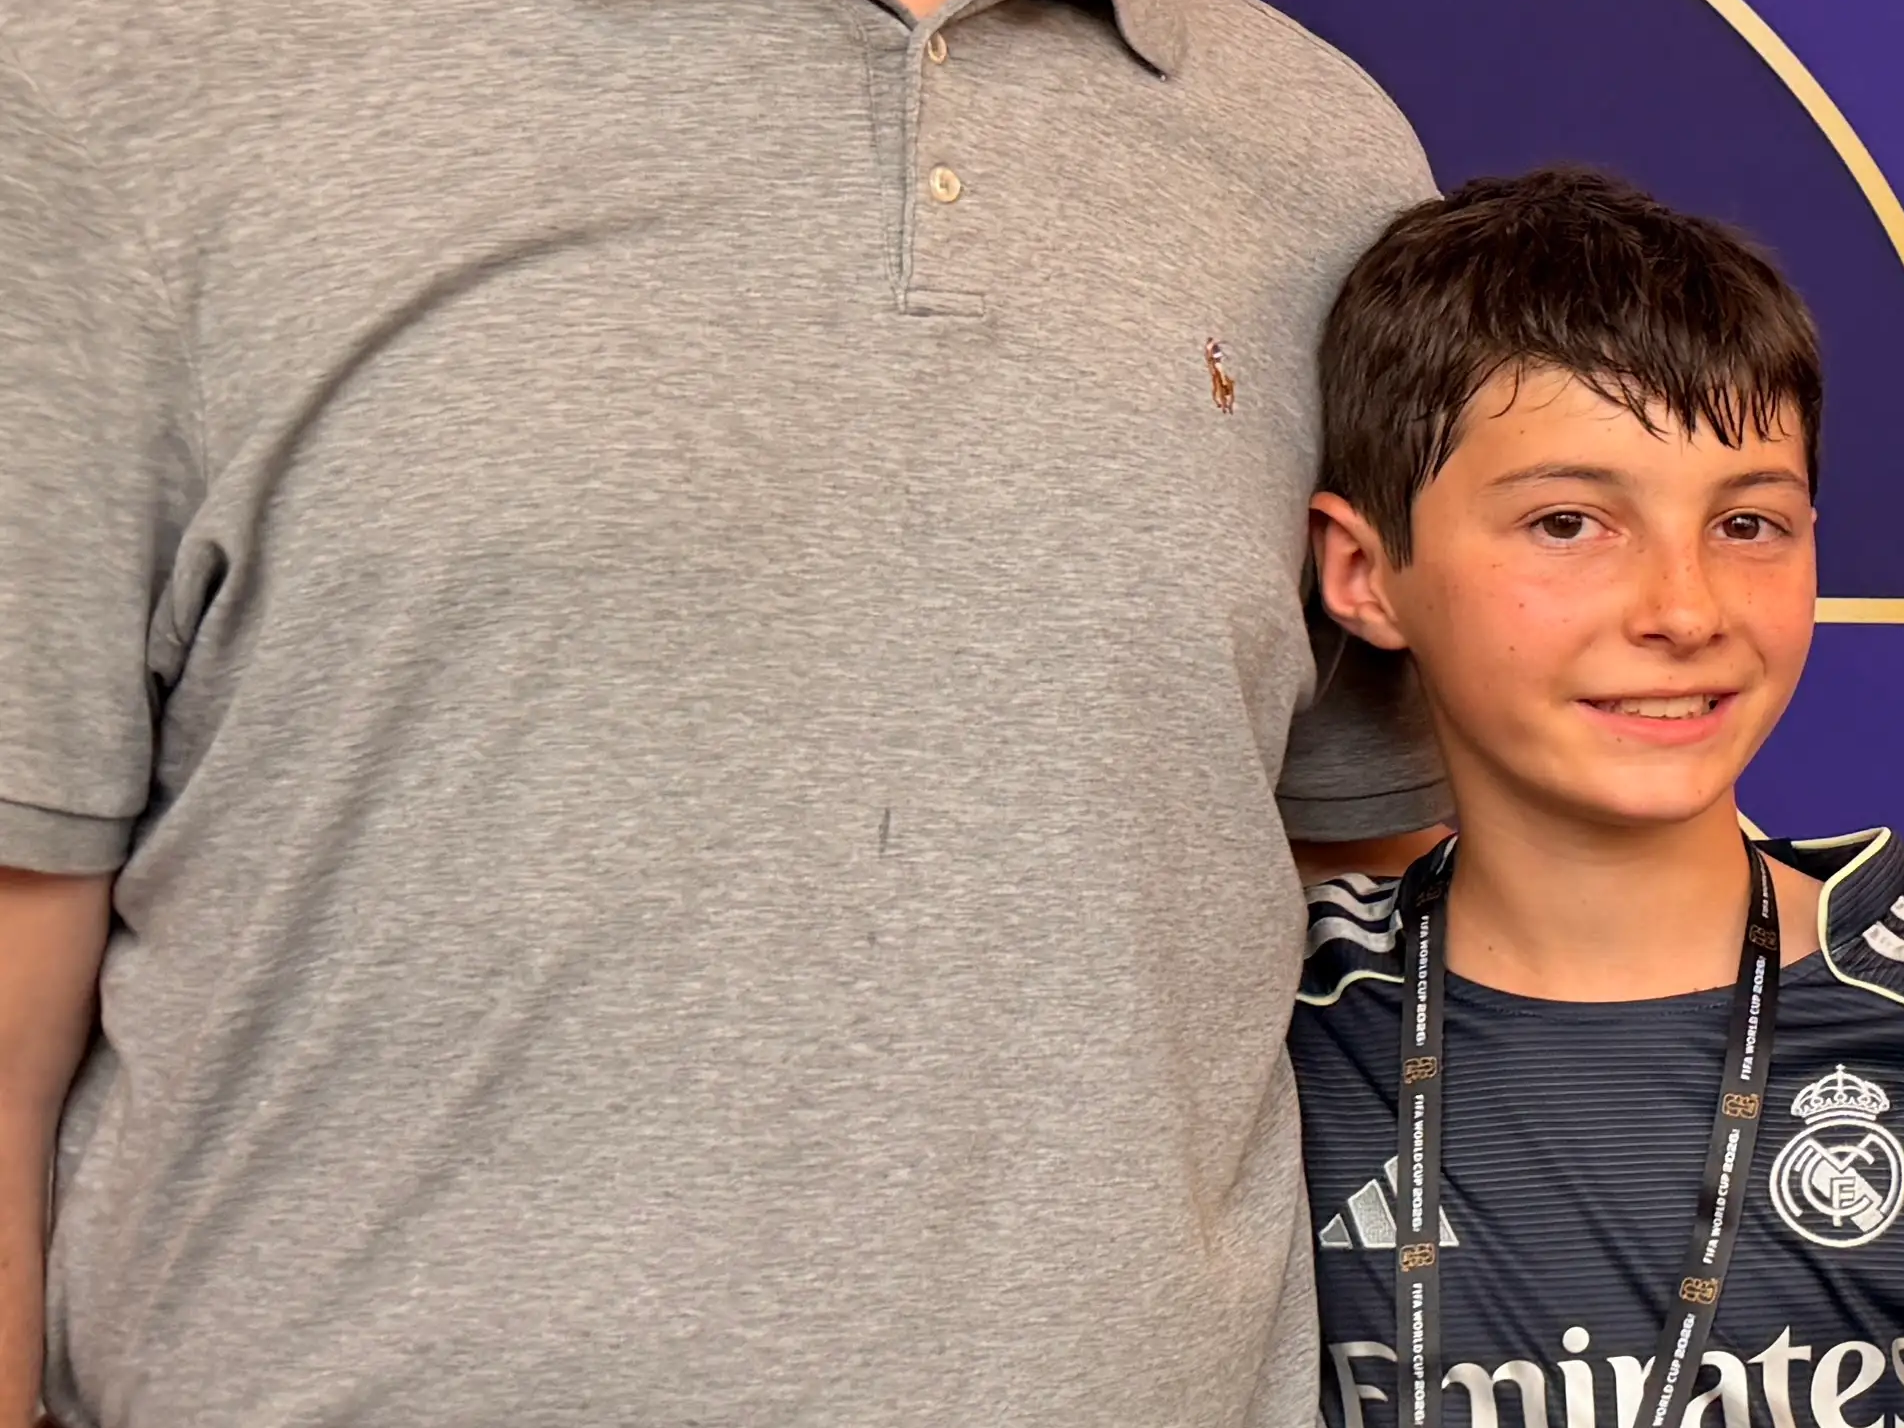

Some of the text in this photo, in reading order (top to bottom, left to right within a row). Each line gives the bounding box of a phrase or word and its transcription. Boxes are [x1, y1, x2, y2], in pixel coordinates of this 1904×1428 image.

[1718, 1173, 1730, 1197] CUP
[1711, 1197, 1728, 1237] WORLD
[1652, 1384, 1674, 1427] WORLD
[1667, 1359, 1681, 1383] CUP
